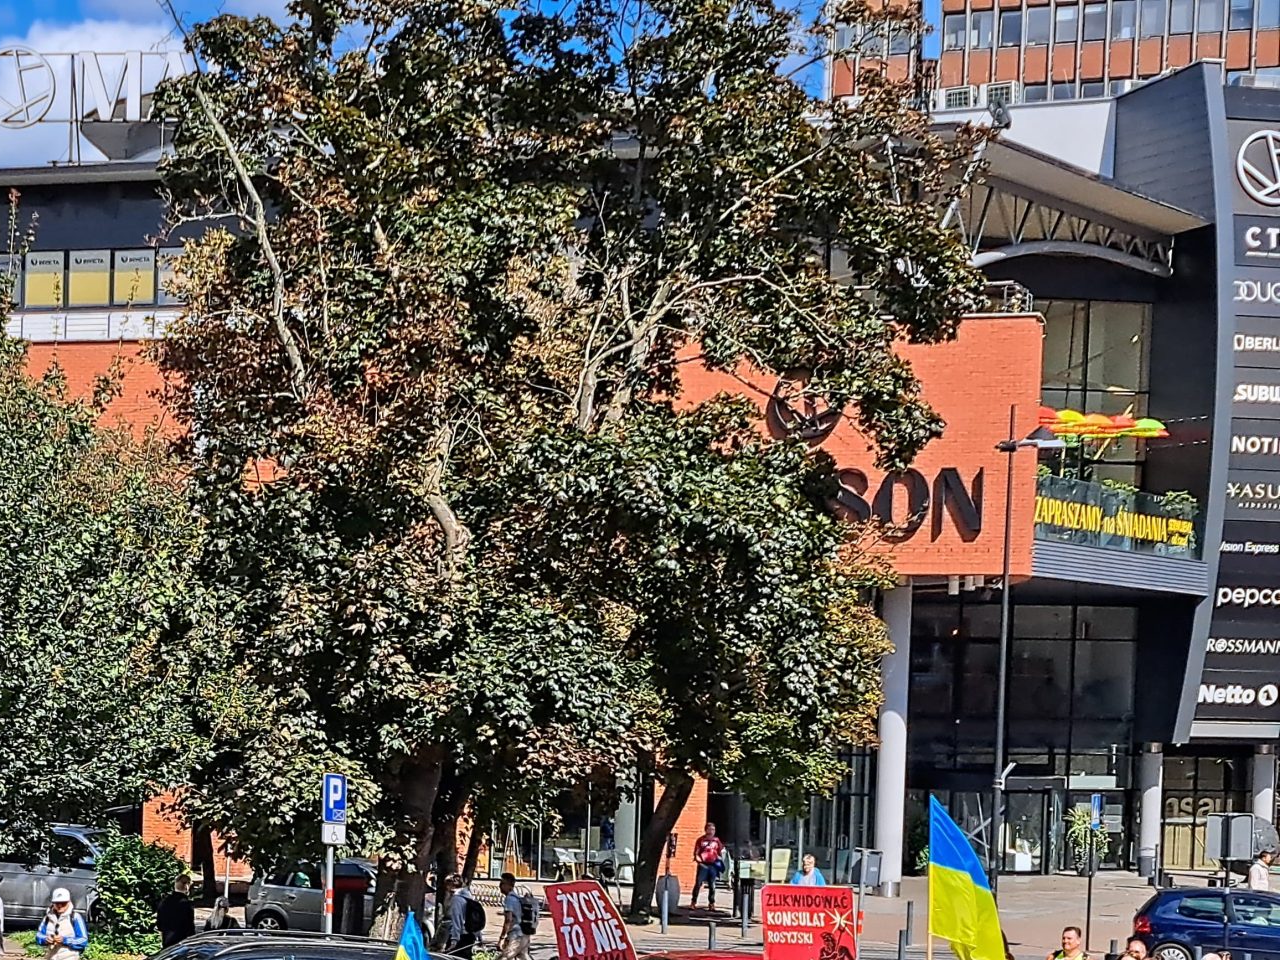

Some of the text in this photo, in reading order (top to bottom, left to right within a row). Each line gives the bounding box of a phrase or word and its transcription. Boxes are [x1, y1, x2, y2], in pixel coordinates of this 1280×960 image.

[1034, 496, 1167, 542] ZAPRASZAMY na ŚNIADANIA
[1245, 542, 1279, 554] Express
[1197, 684, 1256, 703] Netto
[329, 778, 342, 809] P
[557, 889, 611, 925] ŻYCIE
[766, 892, 848, 909] ZLIKWIDOWAĆ
[767, 911, 825, 927] KONSULAT
[561, 918, 627, 958] TO NIE
[767, 930, 813, 944] ROSYJSKI
